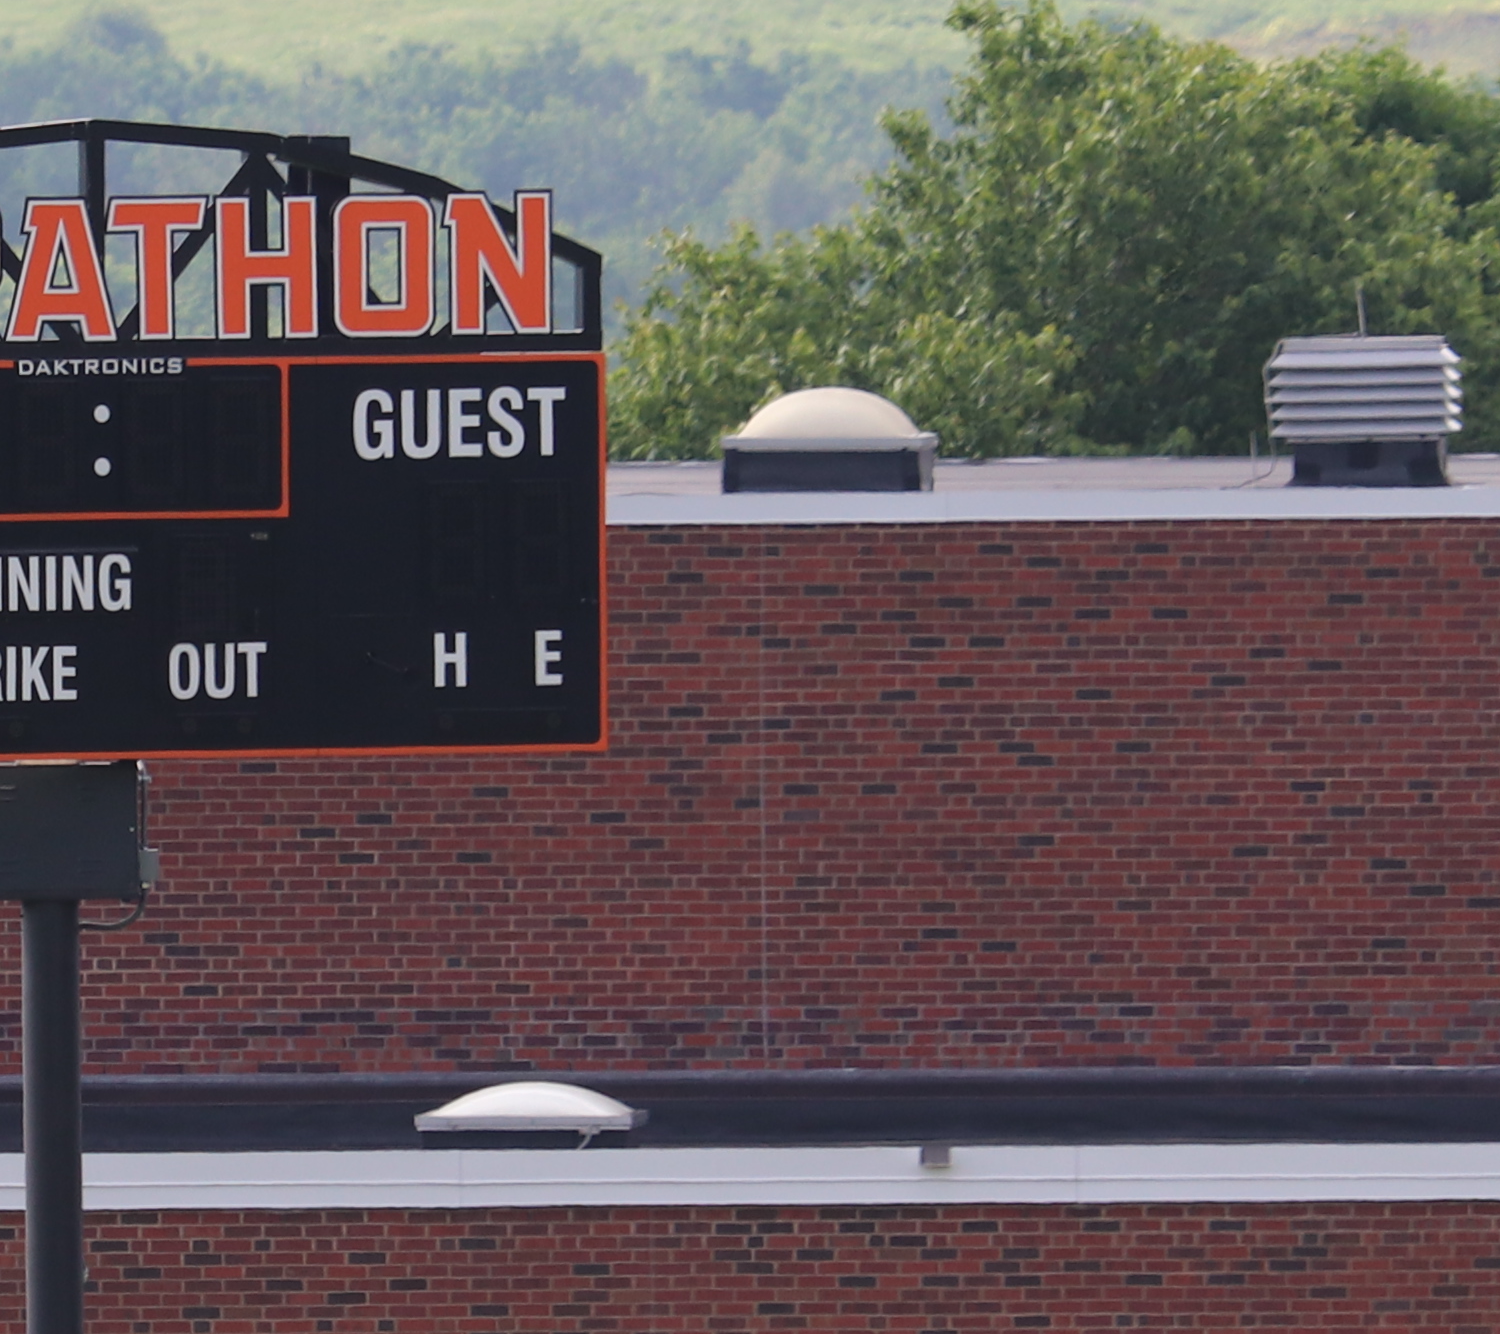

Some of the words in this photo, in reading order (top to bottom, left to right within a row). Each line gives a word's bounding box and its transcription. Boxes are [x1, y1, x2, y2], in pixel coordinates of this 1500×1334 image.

[17, 357, 184, 377] DAKTRONICS
[352, 385, 567, 460] GUEST
[168, 641, 268, 701] OUT
[433, 632, 468, 688] H
[534, 629, 564, 686] E
